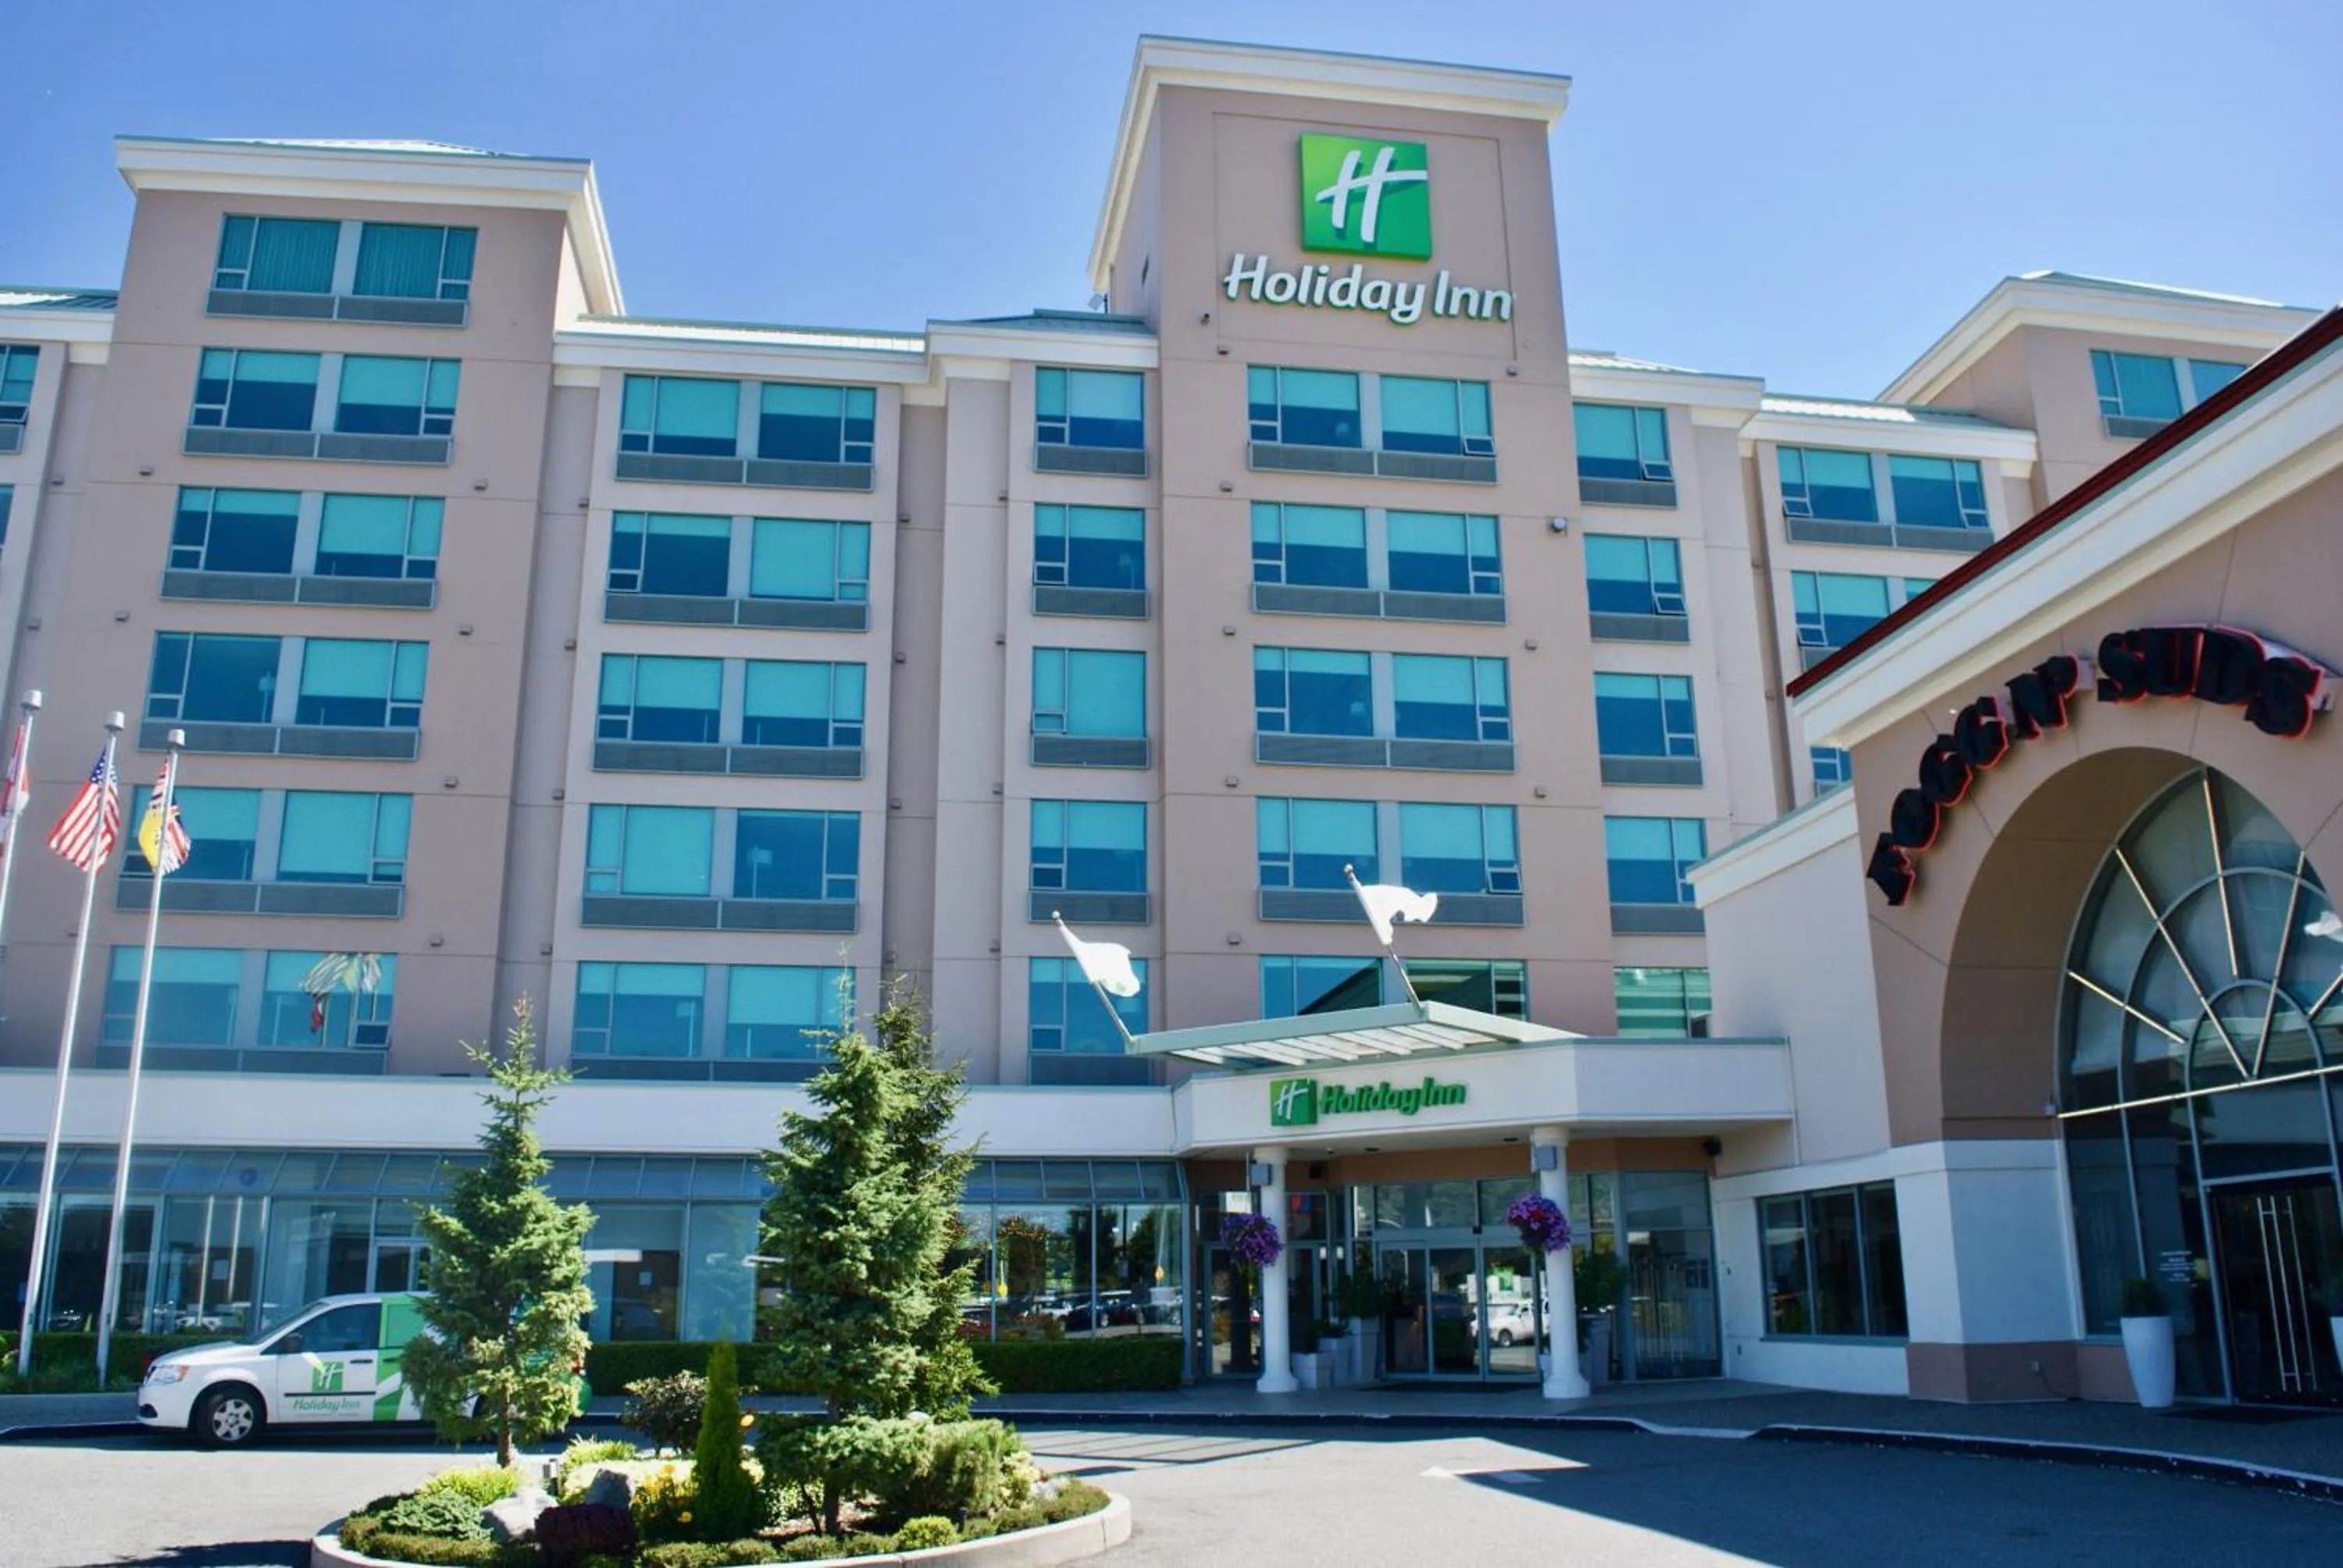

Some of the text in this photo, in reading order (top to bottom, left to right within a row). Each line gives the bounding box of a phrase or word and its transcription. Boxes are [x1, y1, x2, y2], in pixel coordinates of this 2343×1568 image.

[1224, 253, 1512, 324] Holiday Inn
[1867, 696, 2010, 906] FOGG
[2098, 624, 2323, 739] SUDS
[1320, 1077, 1467, 1115] Holiday Inn
[292, 1397, 361, 1412] Holiday Inn
